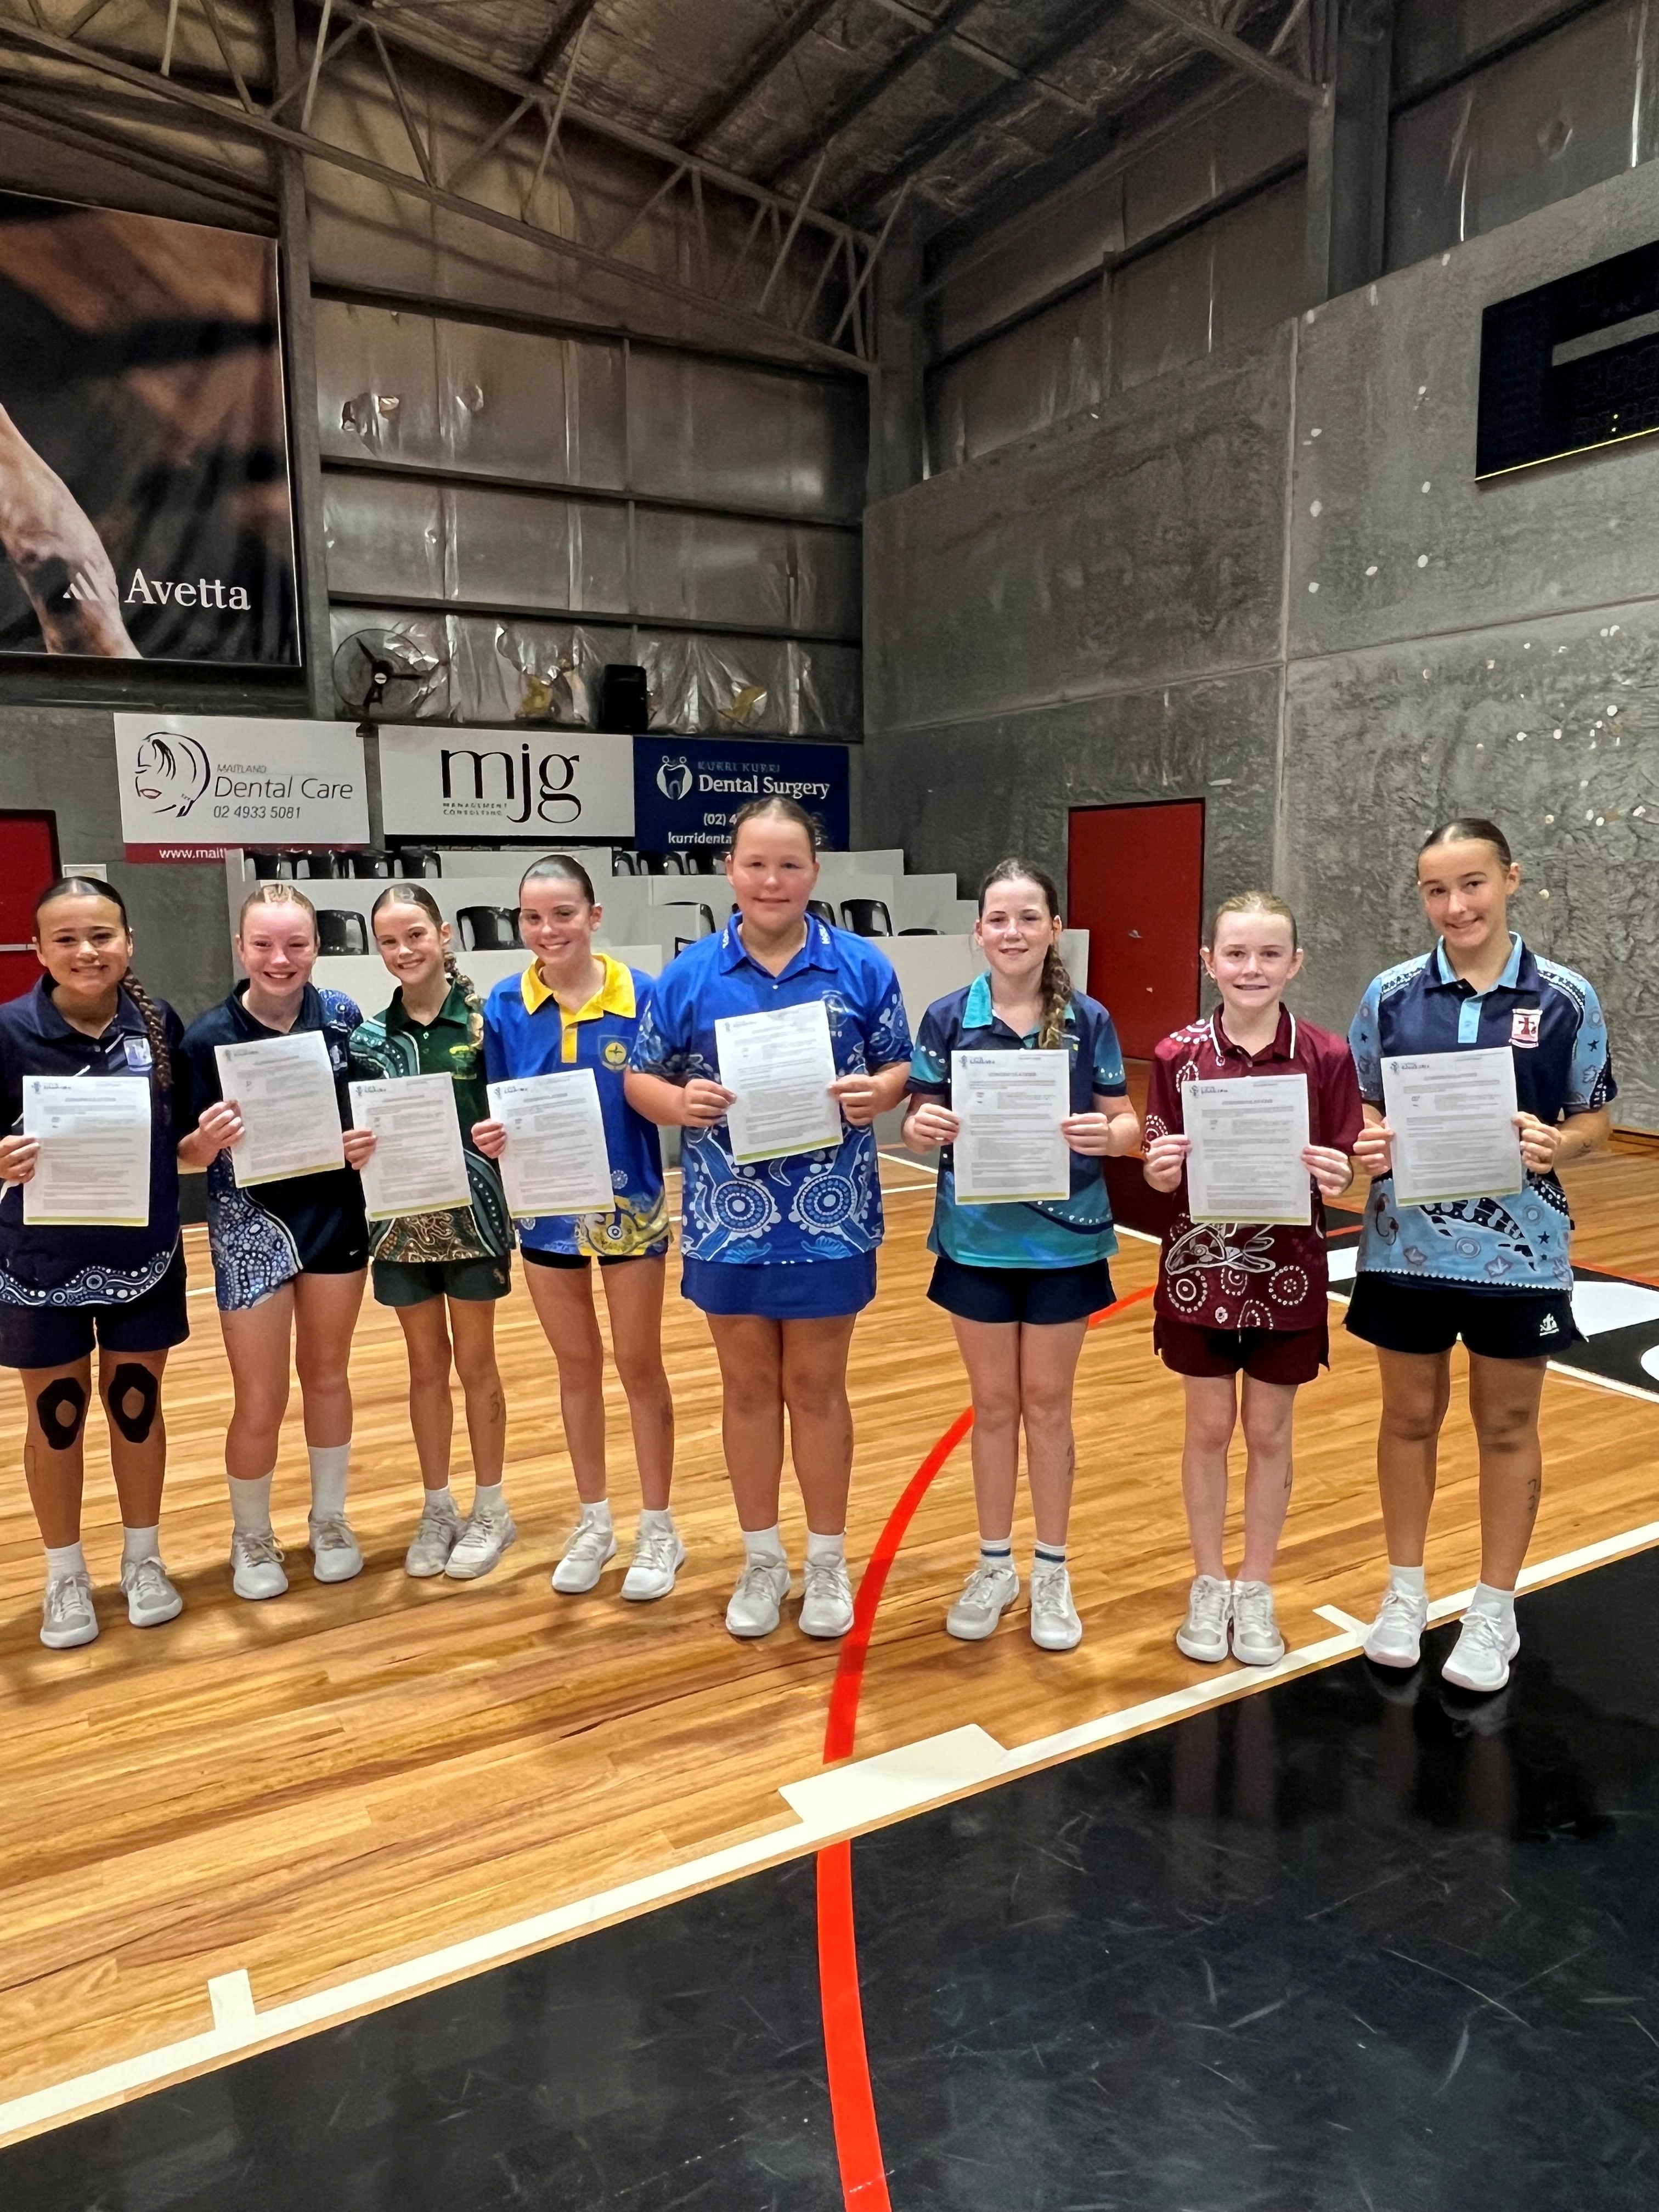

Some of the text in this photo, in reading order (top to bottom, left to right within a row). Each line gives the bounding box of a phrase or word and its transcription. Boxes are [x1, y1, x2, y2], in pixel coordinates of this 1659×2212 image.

[124, 568, 251, 610] Avetta
[215, 775, 353, 799] Dental Care
[441, 743, 581, 823] mjg
[699, 775, 830, 799] Dental Surgery
[213, 805, 301, 819] 02 4933 5081
[703, 813, 726, 826] (02)
